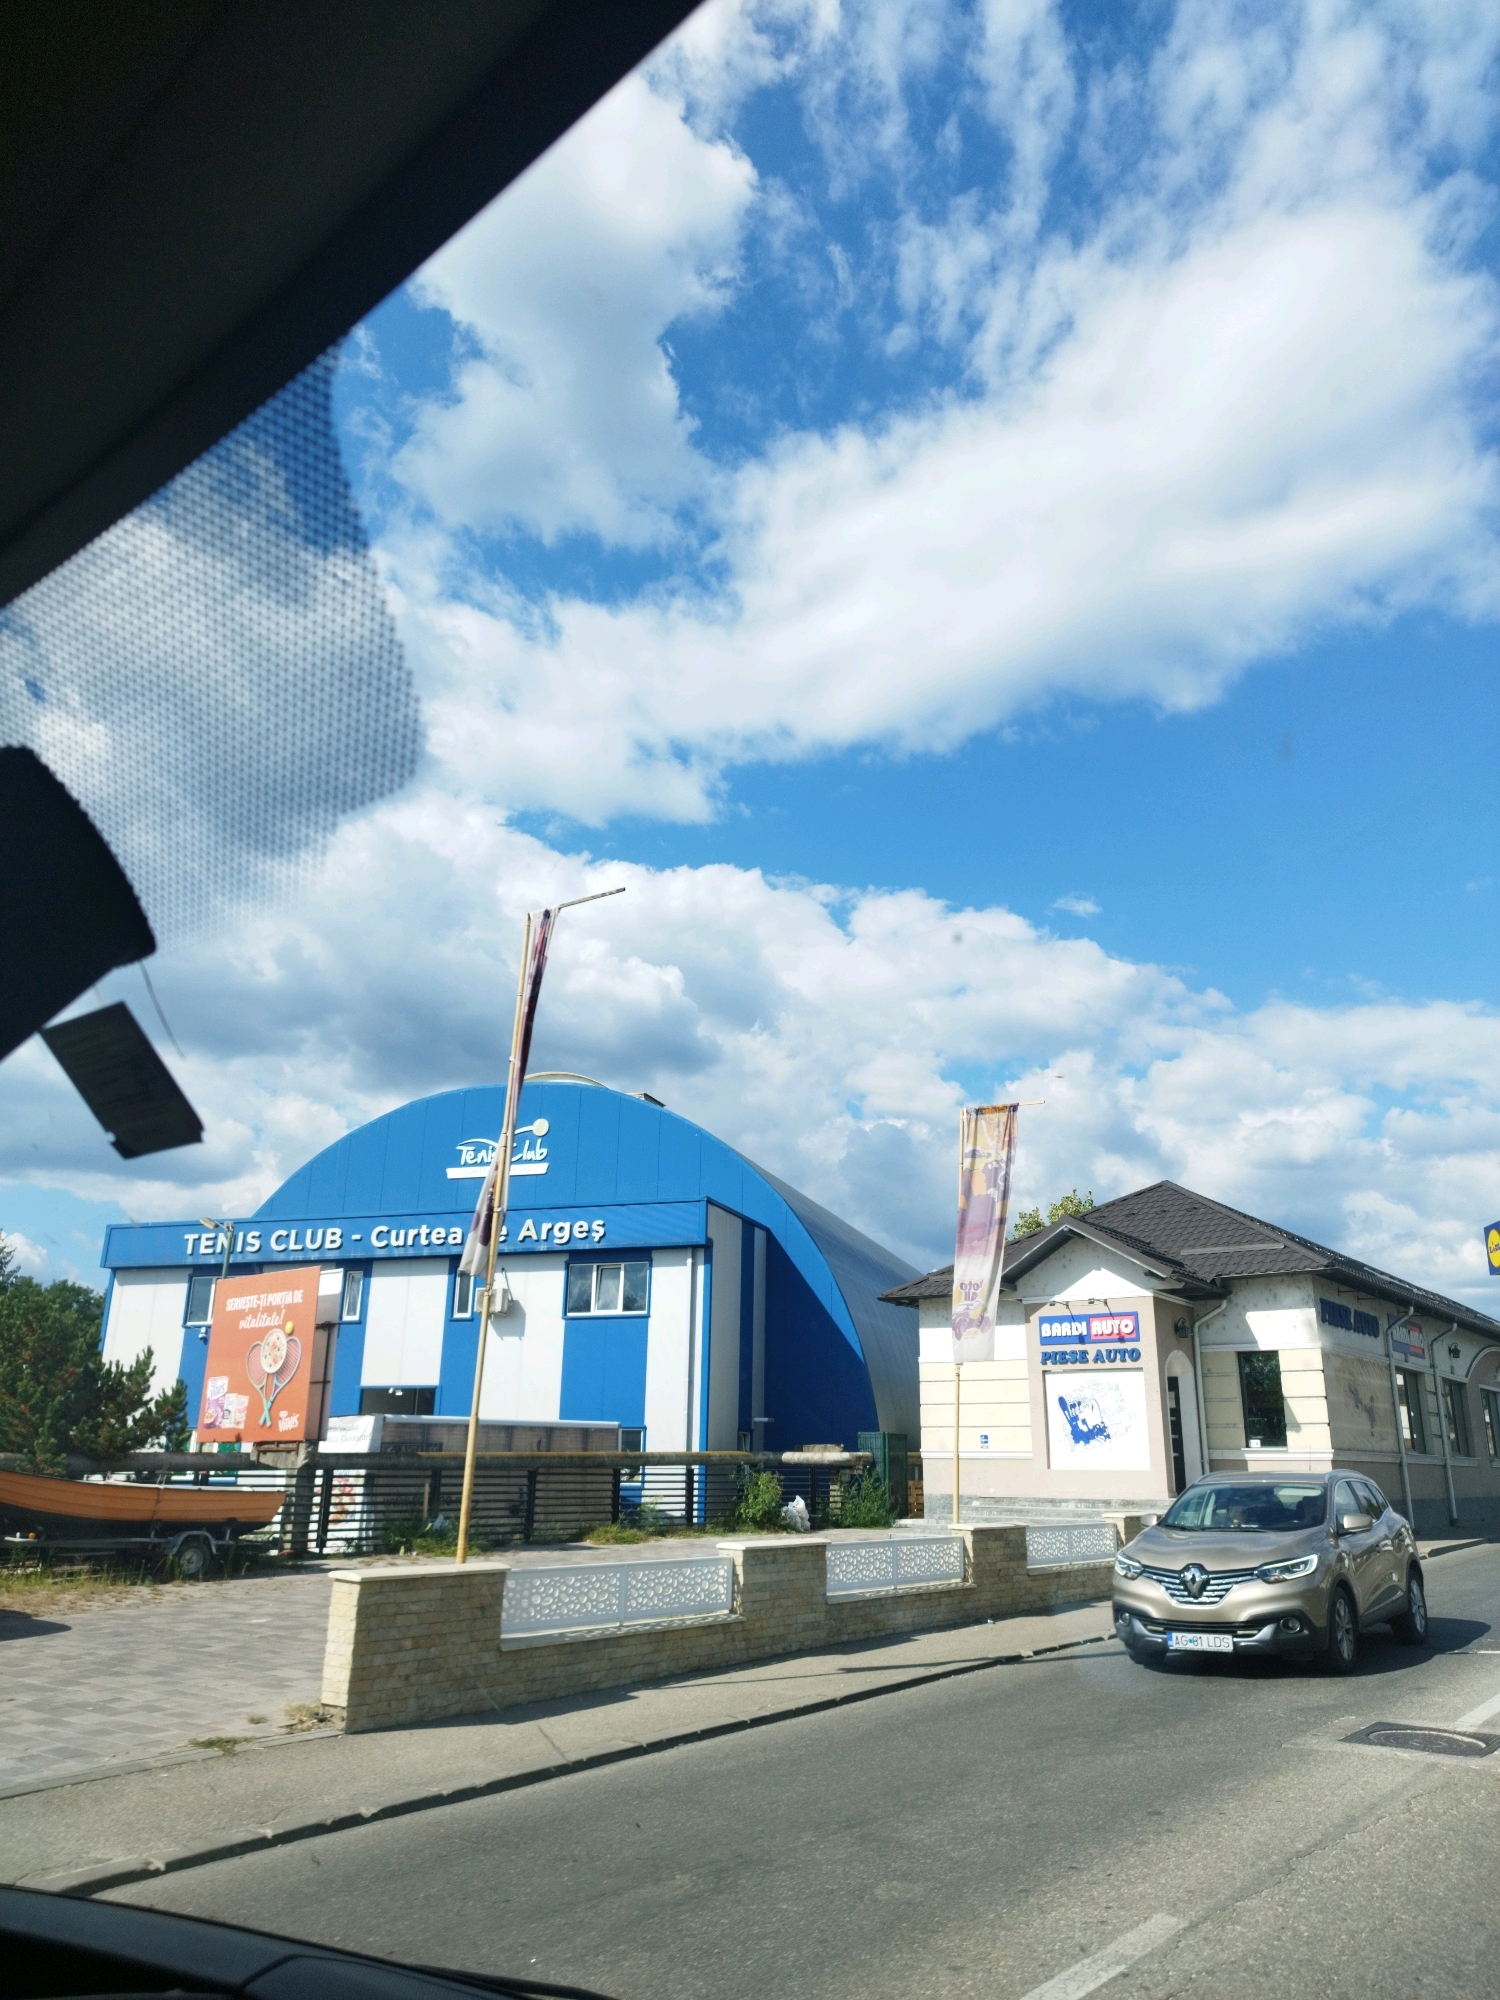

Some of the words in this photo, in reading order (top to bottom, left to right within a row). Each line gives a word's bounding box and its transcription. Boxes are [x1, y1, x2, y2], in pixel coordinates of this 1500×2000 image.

[455, 1145, 498, 1166] Teni
[184, 1231, 262, 1255] TENIS
[270, 1228, 343, 1252] CLUB
[370, 1224, 464, 1249] Curtea
[293, 1289, 304, 1304] DE
[238, 1308, 286, 1330] vitalitate!
[1041, 1320, 1088, 1338] BARDI
[1091, 1318, 1135, 1336] AUTO
[1040, 1350, 1090, 1366] PIESE
[1092, 1347, 1142, 1364] AUTO
[1175, 1635, 1188, 1647] AG
[1207, 1636, 1230, 1648] LDS
